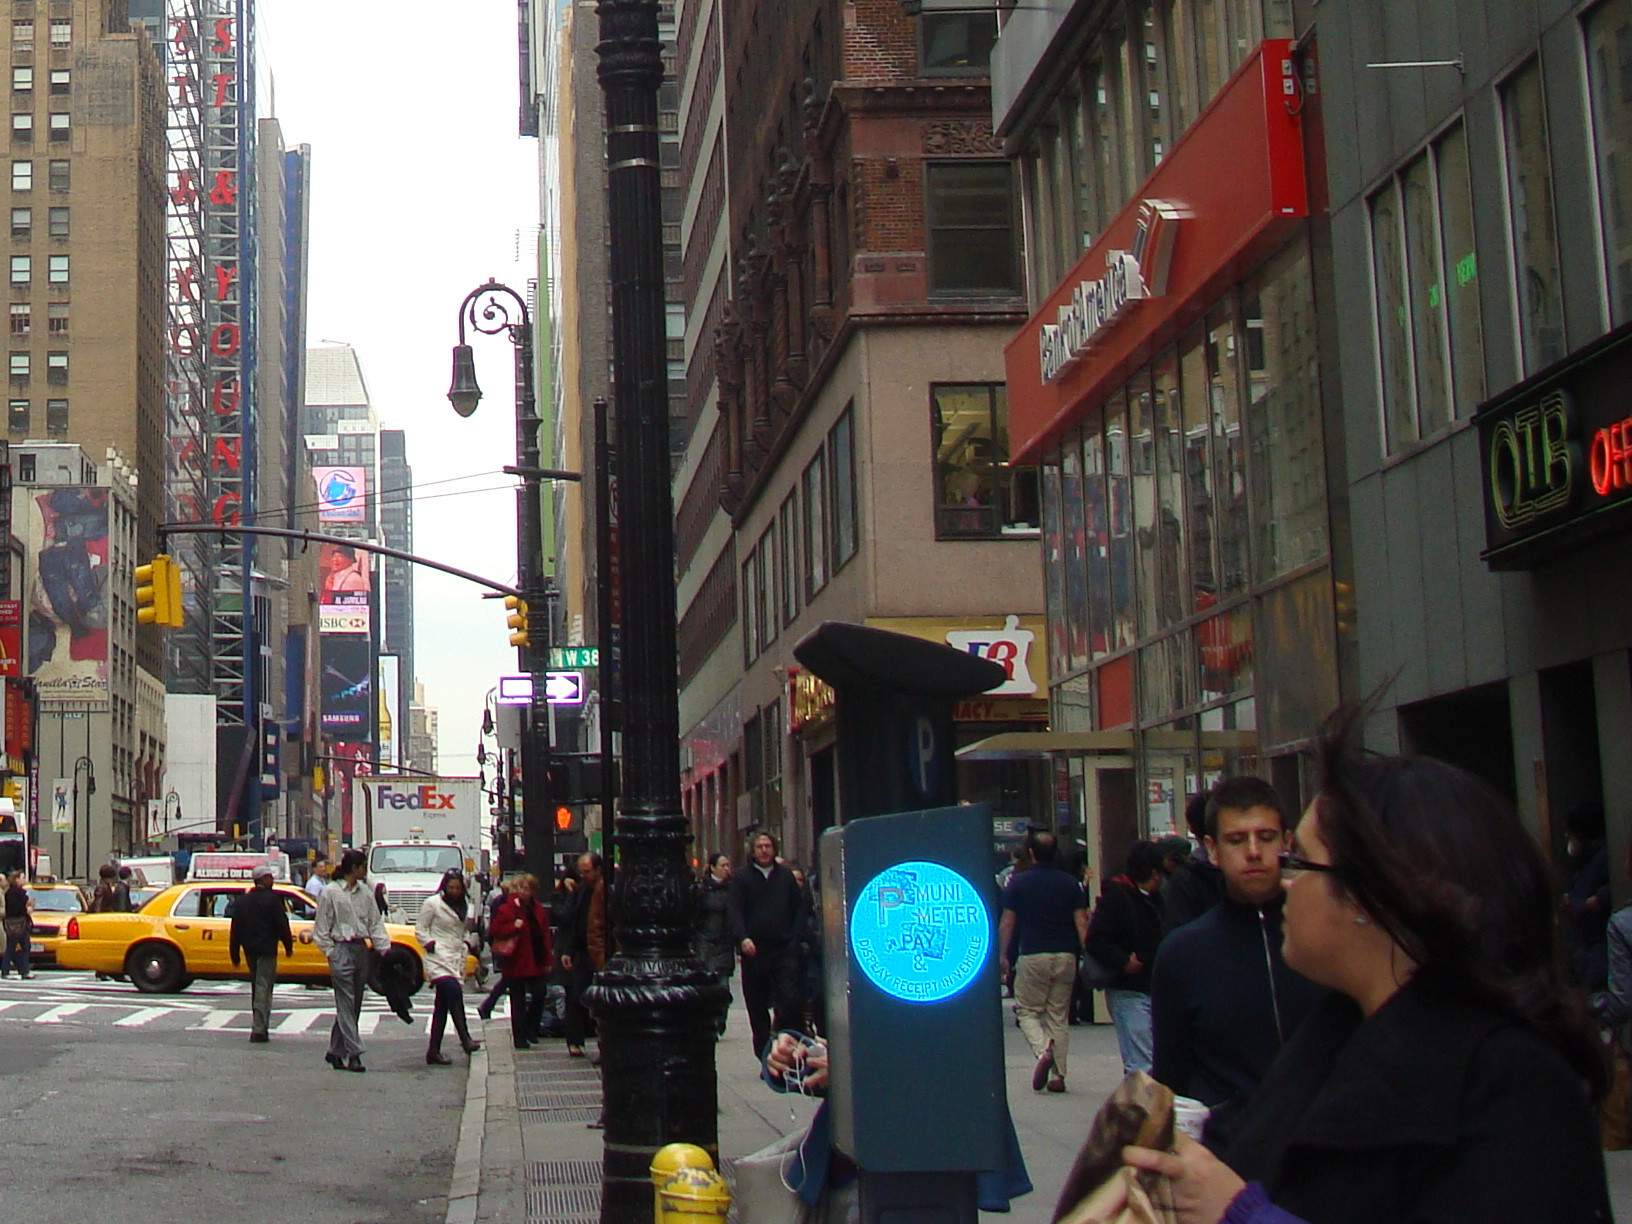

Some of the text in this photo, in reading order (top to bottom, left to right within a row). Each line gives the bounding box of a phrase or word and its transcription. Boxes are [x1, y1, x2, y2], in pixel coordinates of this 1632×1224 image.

[210, 169, 238, 205] &
[210, 265, 242, 527] YOUNG
[1490, 388, 1572, 530] OTB
[565, 649, 599, 666] W 38
[322, 714, 360, 722] SAMSUNG
[919, 717, 934, 792] P
[377, 785, 456, 810] FedEx
[195, 869, 242, 878] ALWAYS ON
[916, 883, 961, 902] MUNI
[917, 906, 979, 925] METER
[902, 930, 937, 950] PAY
[859, 935, 982, 994] DISPLAY RECEIPT IN VEHICLE
[914, 954, 928, 971] &
